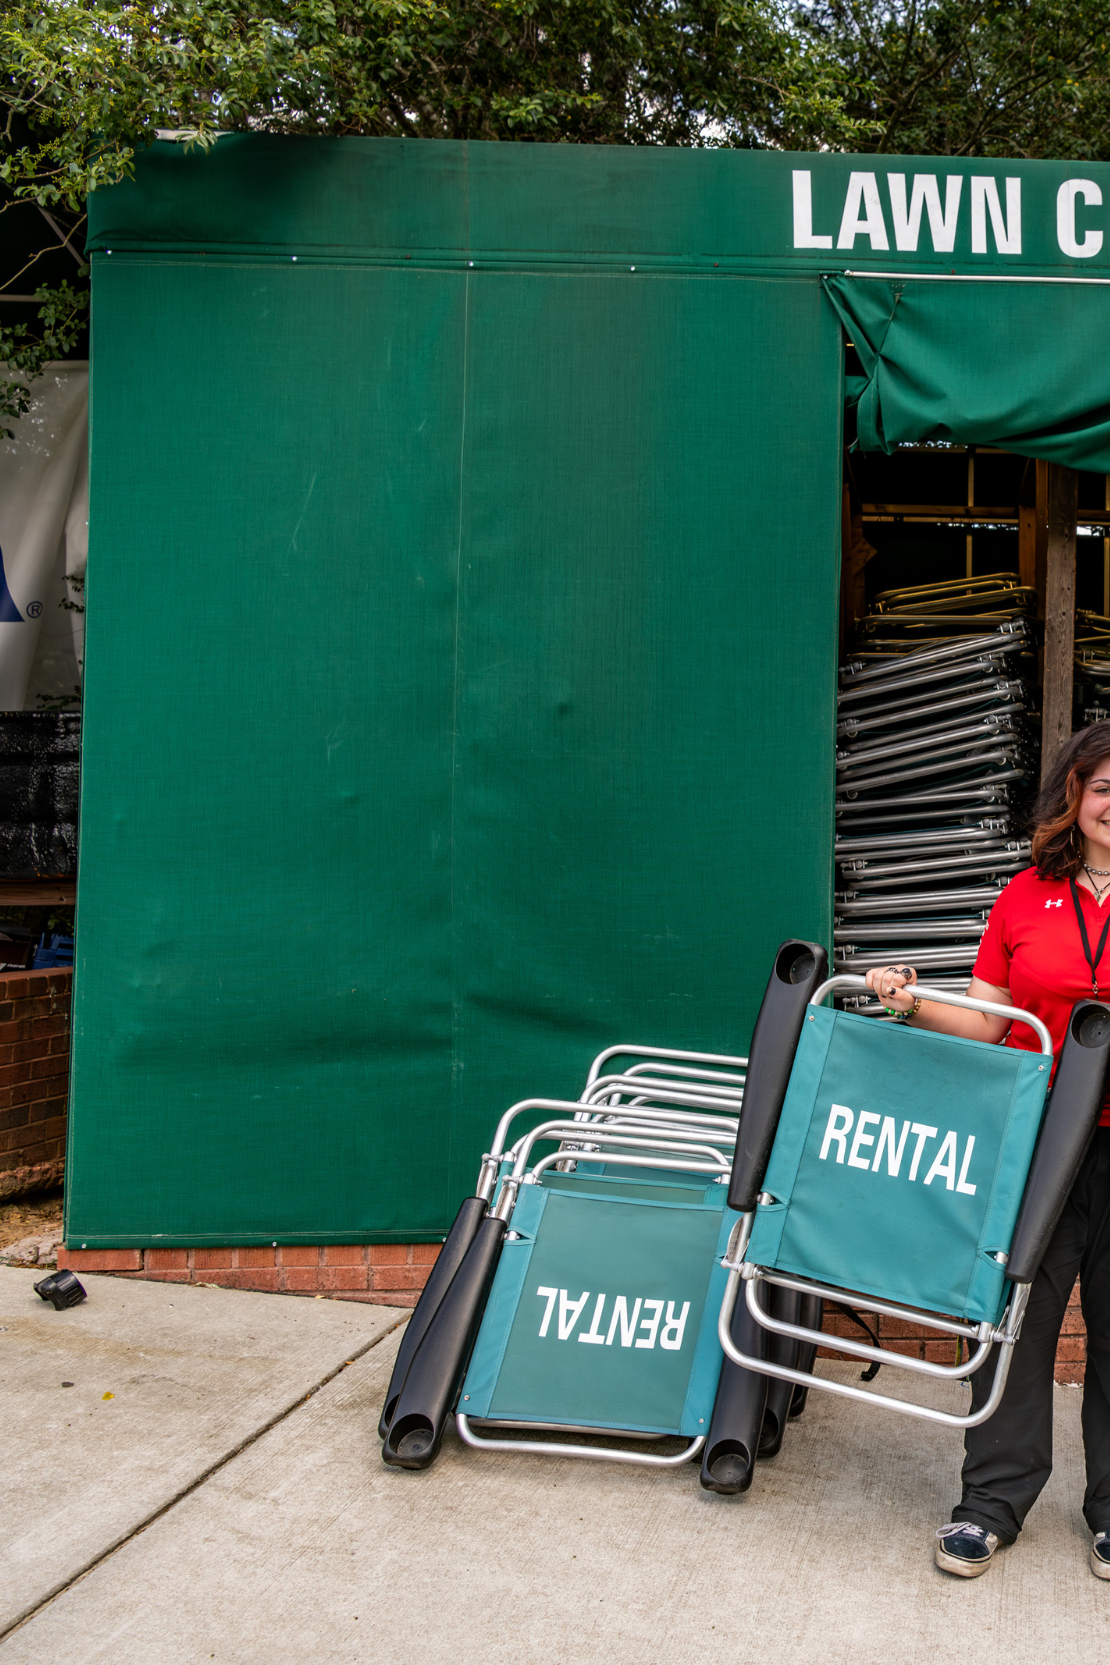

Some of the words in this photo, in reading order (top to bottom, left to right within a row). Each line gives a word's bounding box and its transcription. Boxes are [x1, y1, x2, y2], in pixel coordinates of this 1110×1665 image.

[792, 169, 1022, 255] LAWN
[818, 1103, 977, 1196] RENTAL
[536, 1285, 691, 1351] RENTAL
